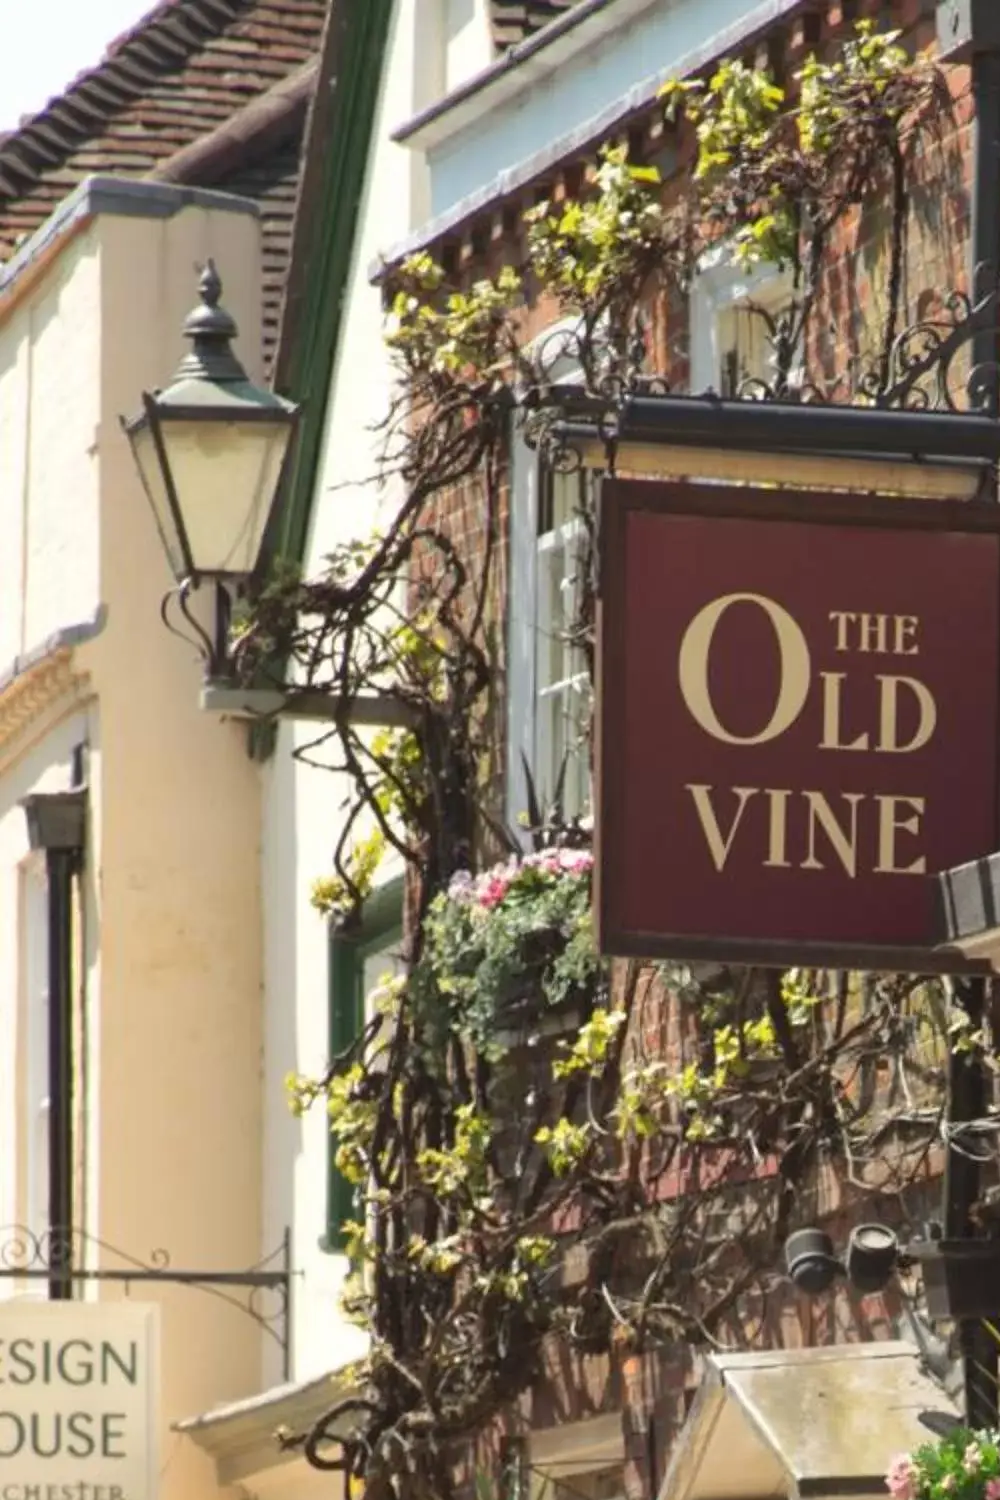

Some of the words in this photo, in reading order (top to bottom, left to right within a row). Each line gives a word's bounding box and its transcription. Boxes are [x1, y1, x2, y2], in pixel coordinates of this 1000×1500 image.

[828, 611, 920, 655] THE
[678, 592, 938, 754] OLD
[685, 784, 927, 879] VINE
[0, 1338, 137, 1386] SIGN
